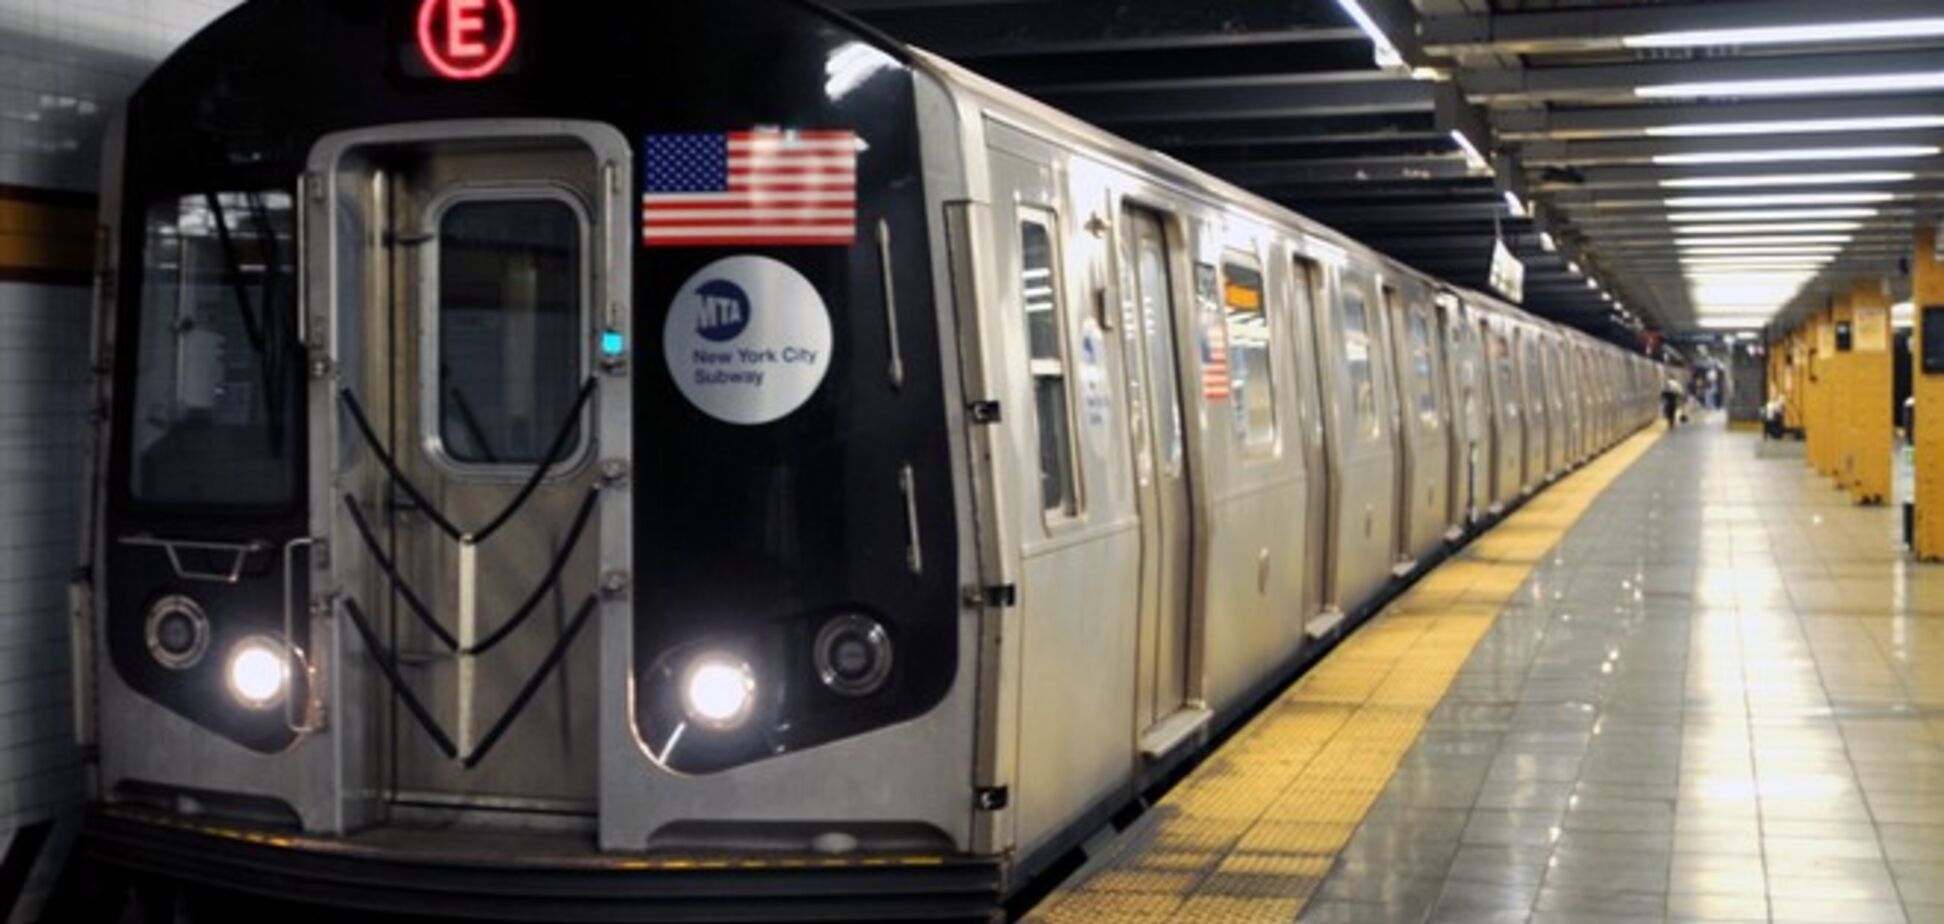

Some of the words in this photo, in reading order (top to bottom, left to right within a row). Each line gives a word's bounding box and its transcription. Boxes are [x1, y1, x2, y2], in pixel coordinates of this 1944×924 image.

[447, 0, 486, 57] E
[696, 294, 743, 328] MTA
[694, 350, 732, 364] New
[738, 348, 777, 363] York
[782, 347, 817, 365] City
[694, 368, 765, 387] Subway
